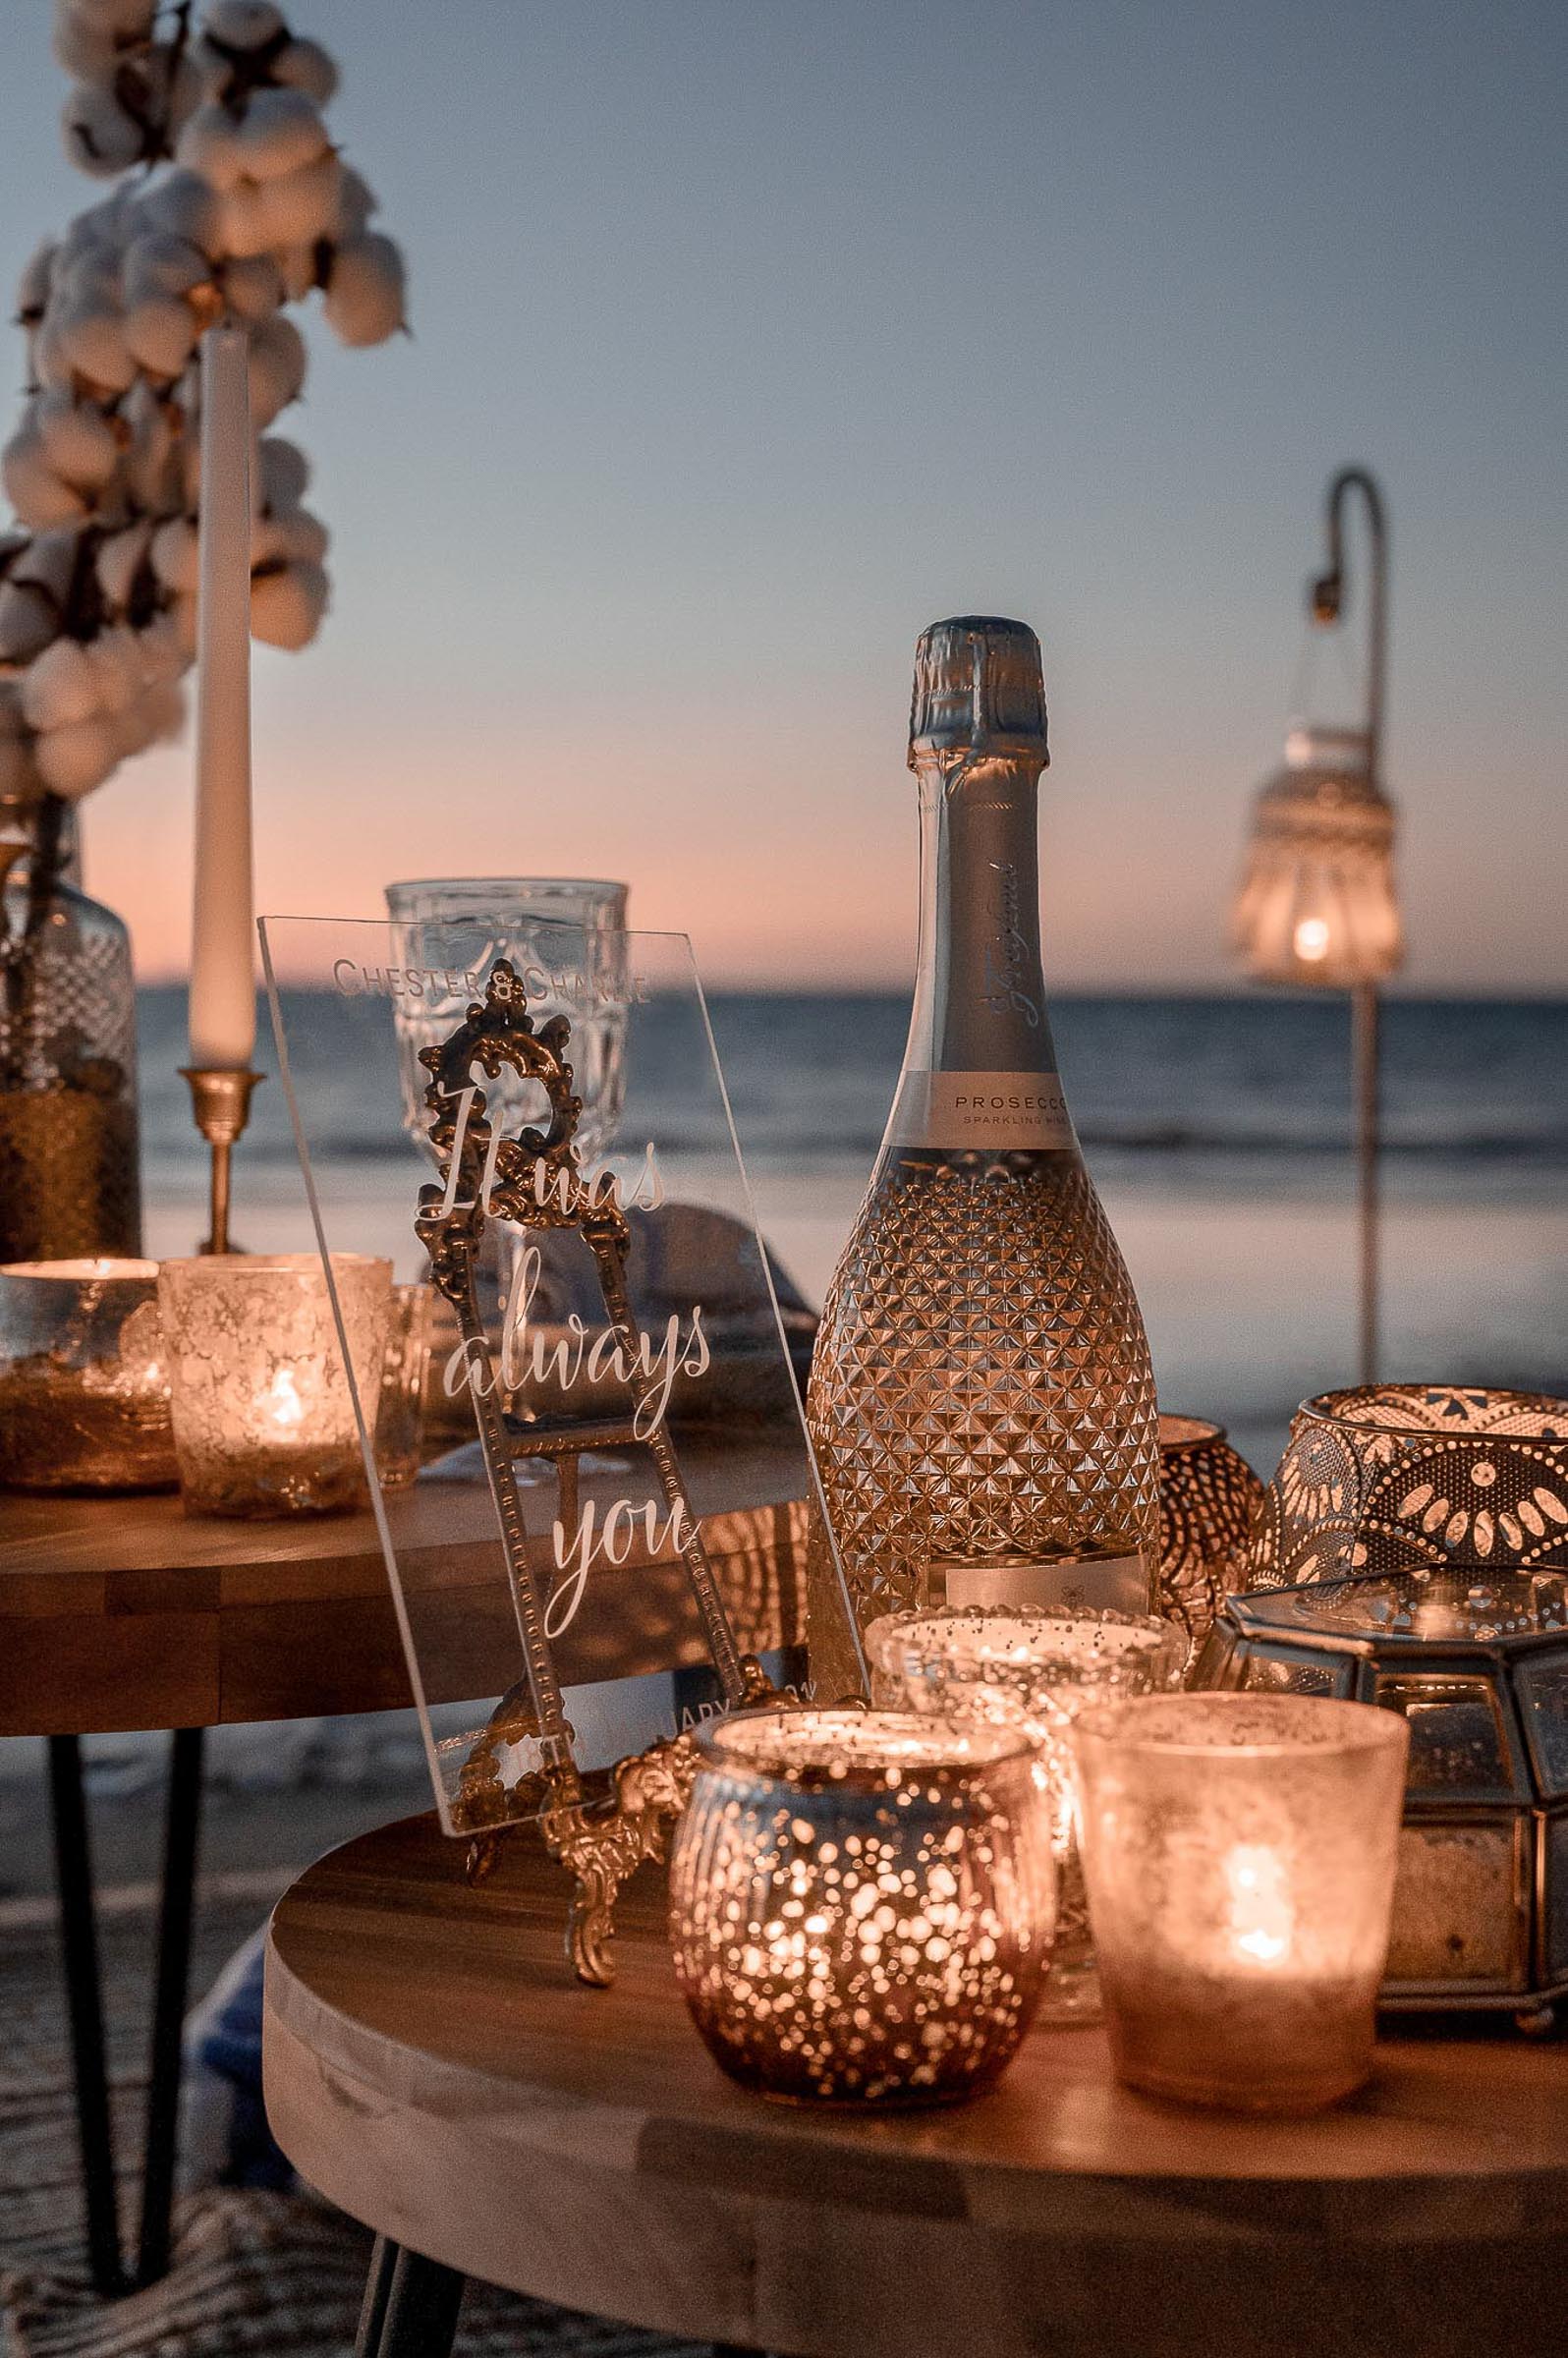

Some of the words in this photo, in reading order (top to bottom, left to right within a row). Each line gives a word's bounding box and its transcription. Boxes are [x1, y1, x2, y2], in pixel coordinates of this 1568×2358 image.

[492, 971, 512, 1000] &
[414, 1080, 507, 1220] It
[534, 1140, 665, 1217] was
[963, 1116, 1041, 1125] SPARKLING
[442, 1246, 710, 1441] always
[543, 1496, 703, 1639] you
